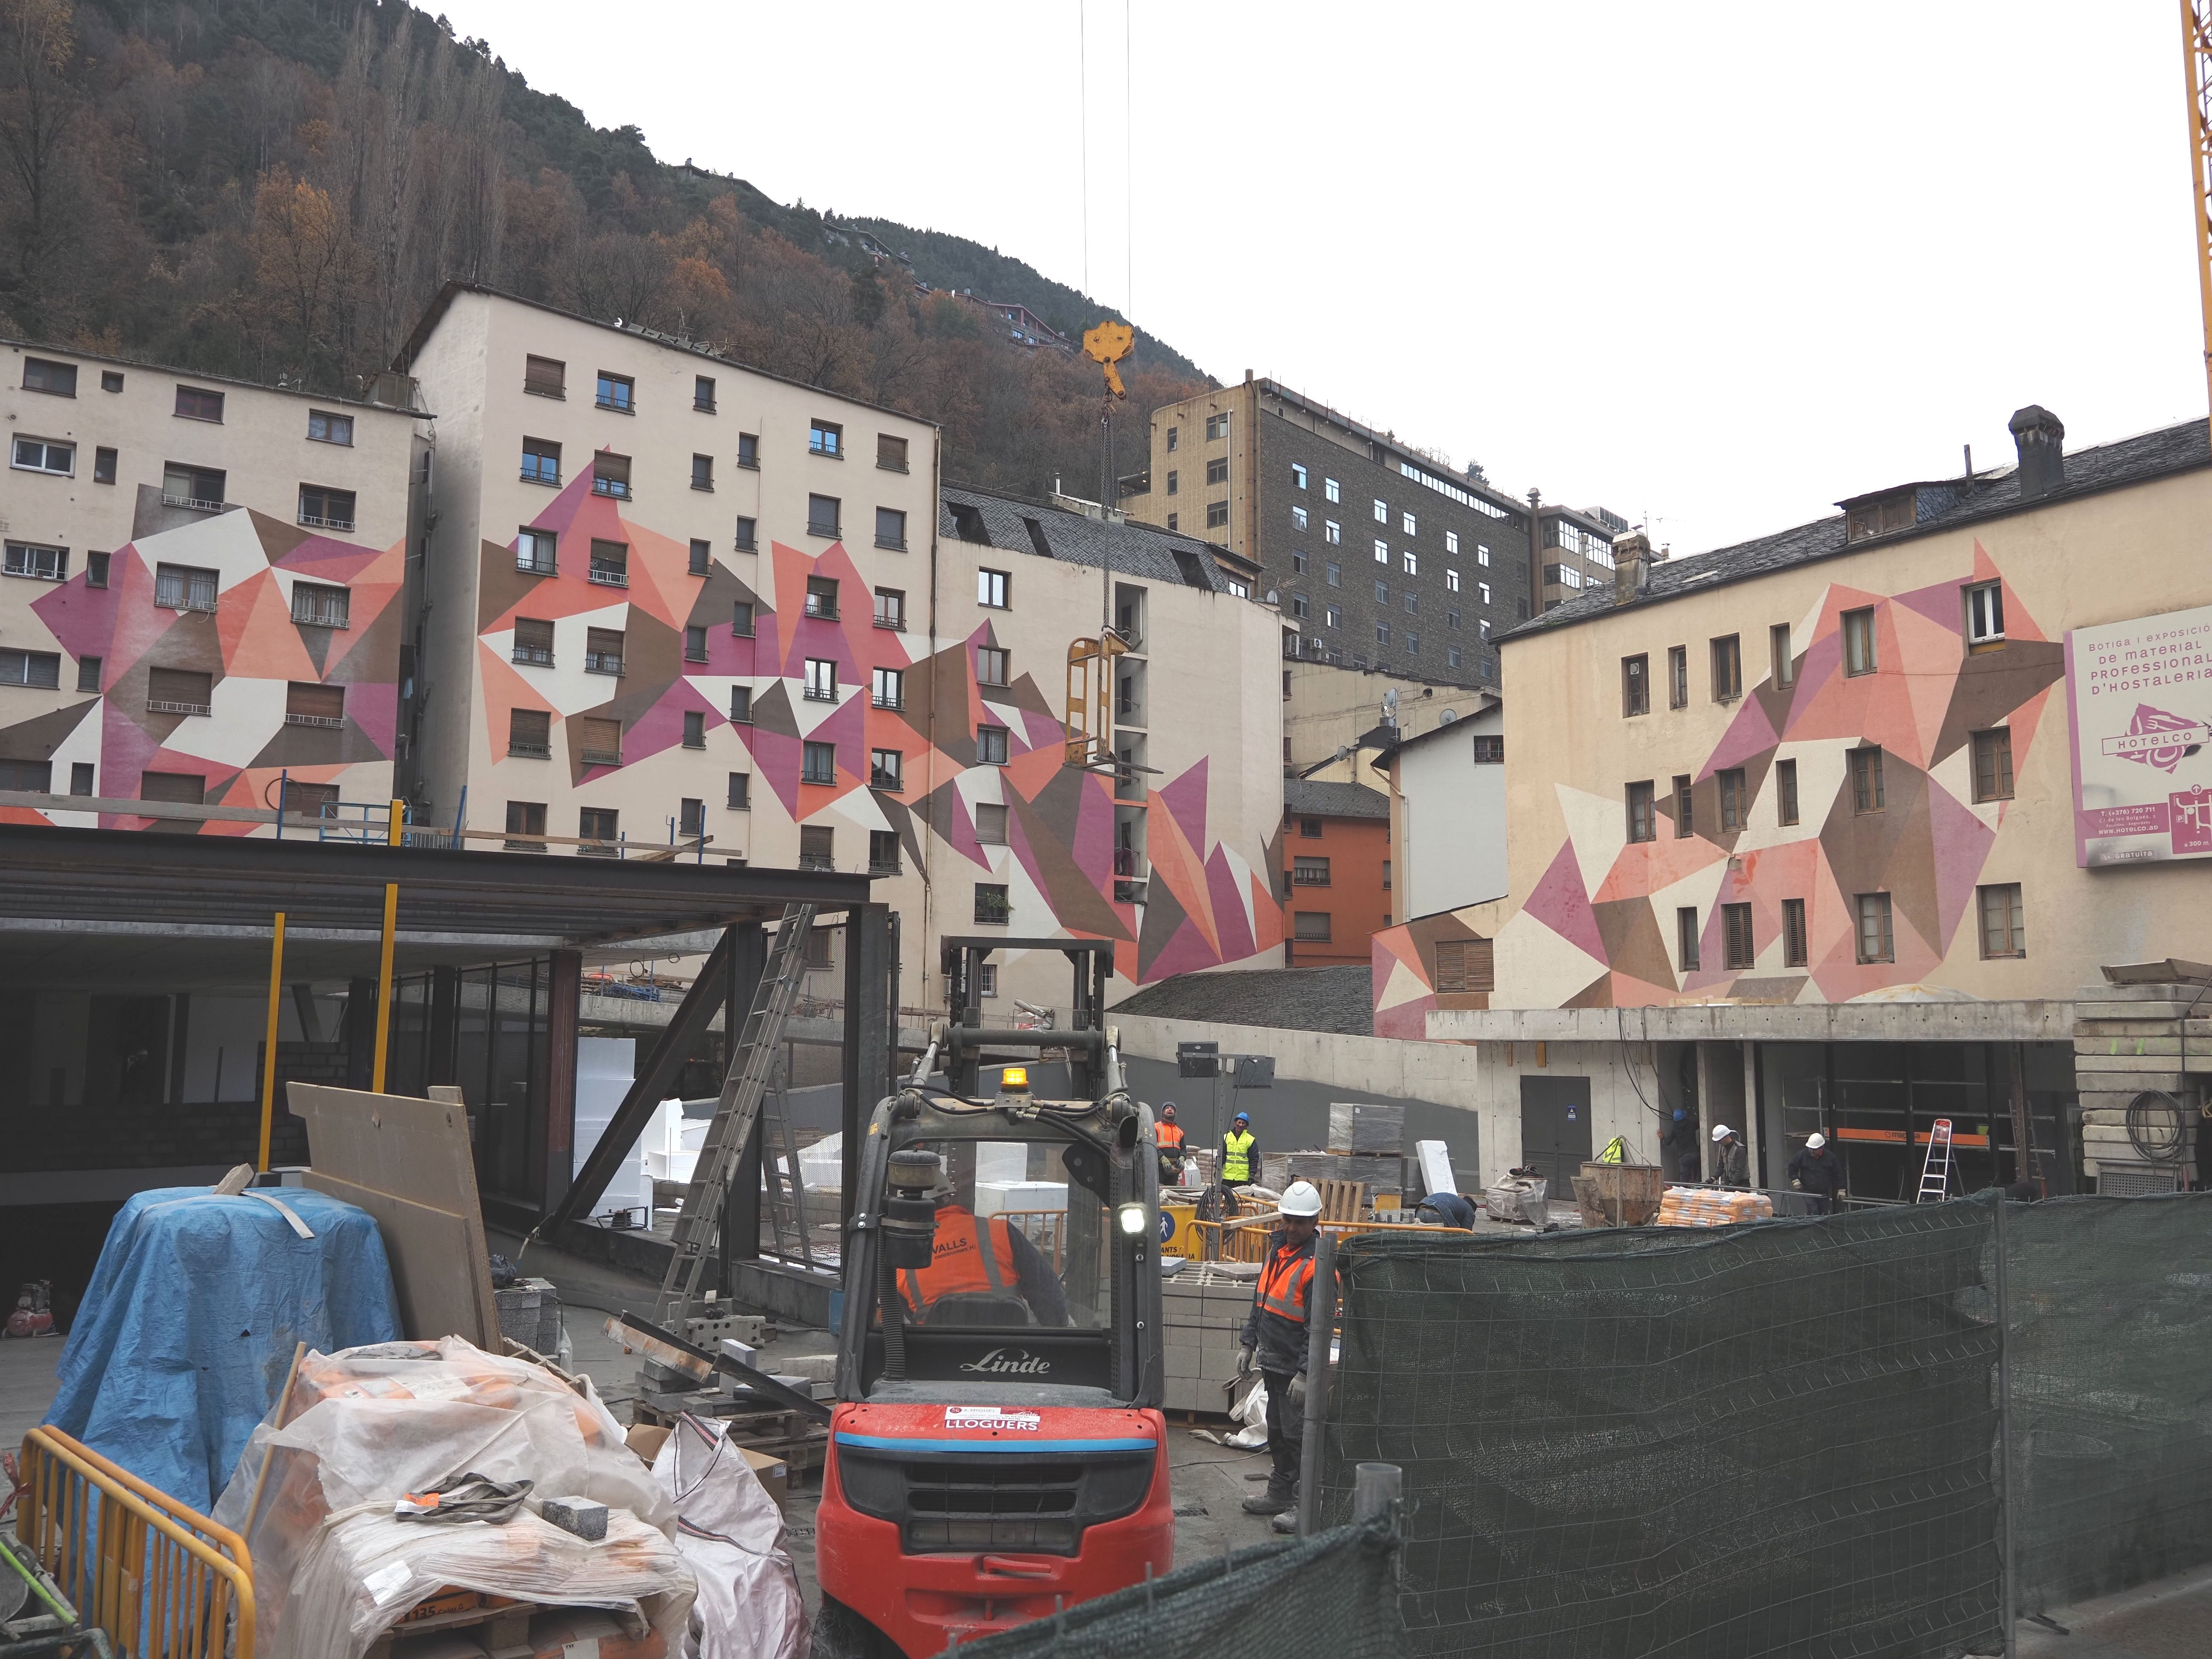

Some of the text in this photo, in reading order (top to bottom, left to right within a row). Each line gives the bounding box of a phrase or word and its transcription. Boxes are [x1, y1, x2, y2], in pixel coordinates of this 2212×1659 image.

[932, 1238, 967, 1254] VALLS
[960, 1348, 1050, 1374] Linde
[946, 1420, 1037, 1430] LLOGUERS
